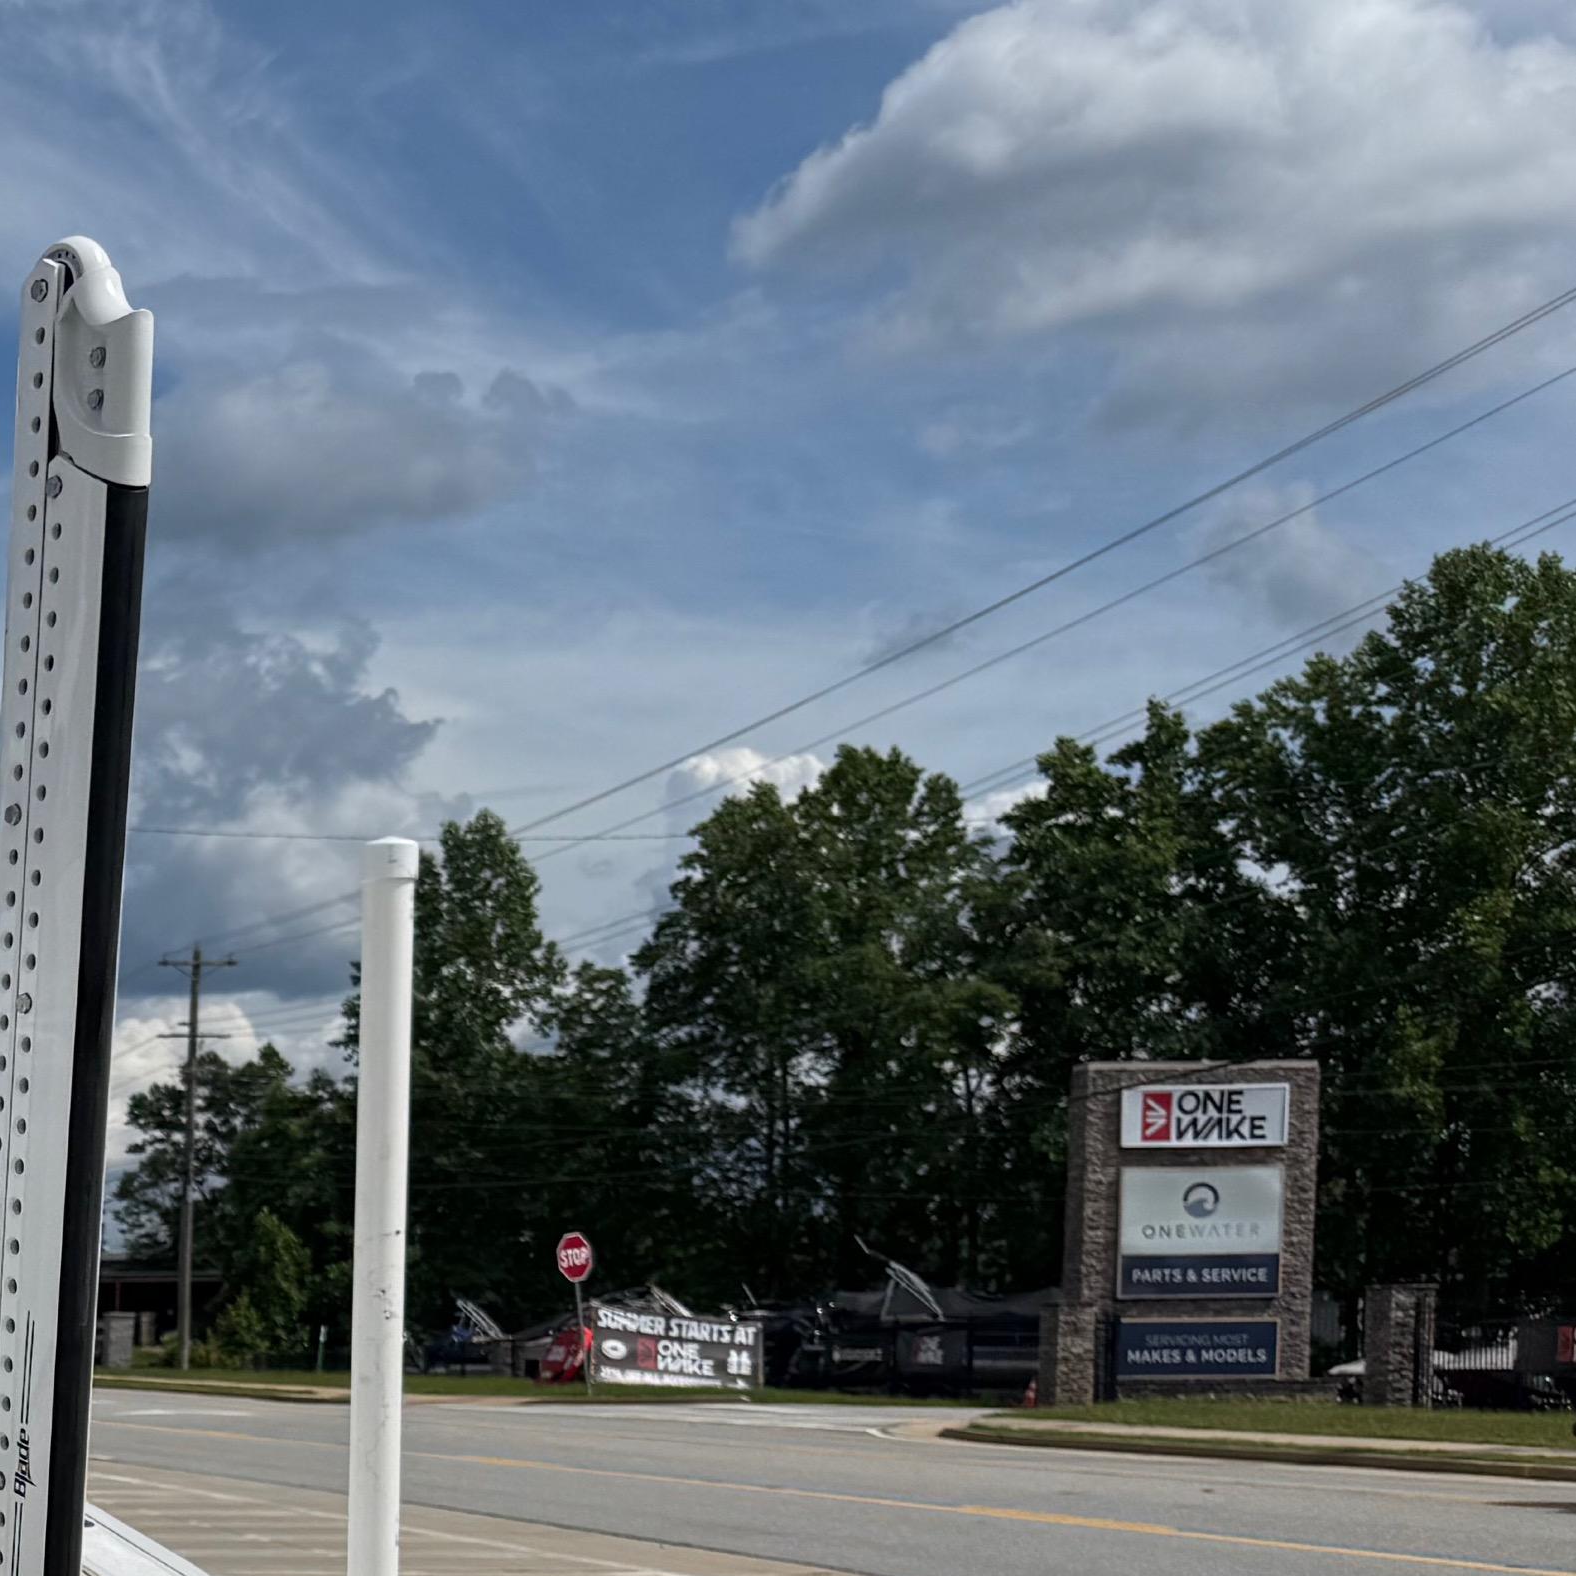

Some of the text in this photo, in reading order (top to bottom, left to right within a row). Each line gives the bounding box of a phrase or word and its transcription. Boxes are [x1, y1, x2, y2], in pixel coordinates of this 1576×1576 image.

[1177, 1090, 1244, 1115] ONE
[1176, 1115, 1267, 1141] WAKE
[1141, 1222, 1260, 1240] ONEWATER
[560, 1247, 590, 1269] STOP
[1132, 1267, 1269, 1284] PARTS & SERVICE
[597, 1309, 757, 1346] SUMMER STARTS AT
[657, 1339, 701, 1359] ONE
[1213, 1333, 1250, 1347] MOST
[1127, 1348, 1268, 1364] MAKES & MODELS
[14, 1428, 37, 1499] Blade
